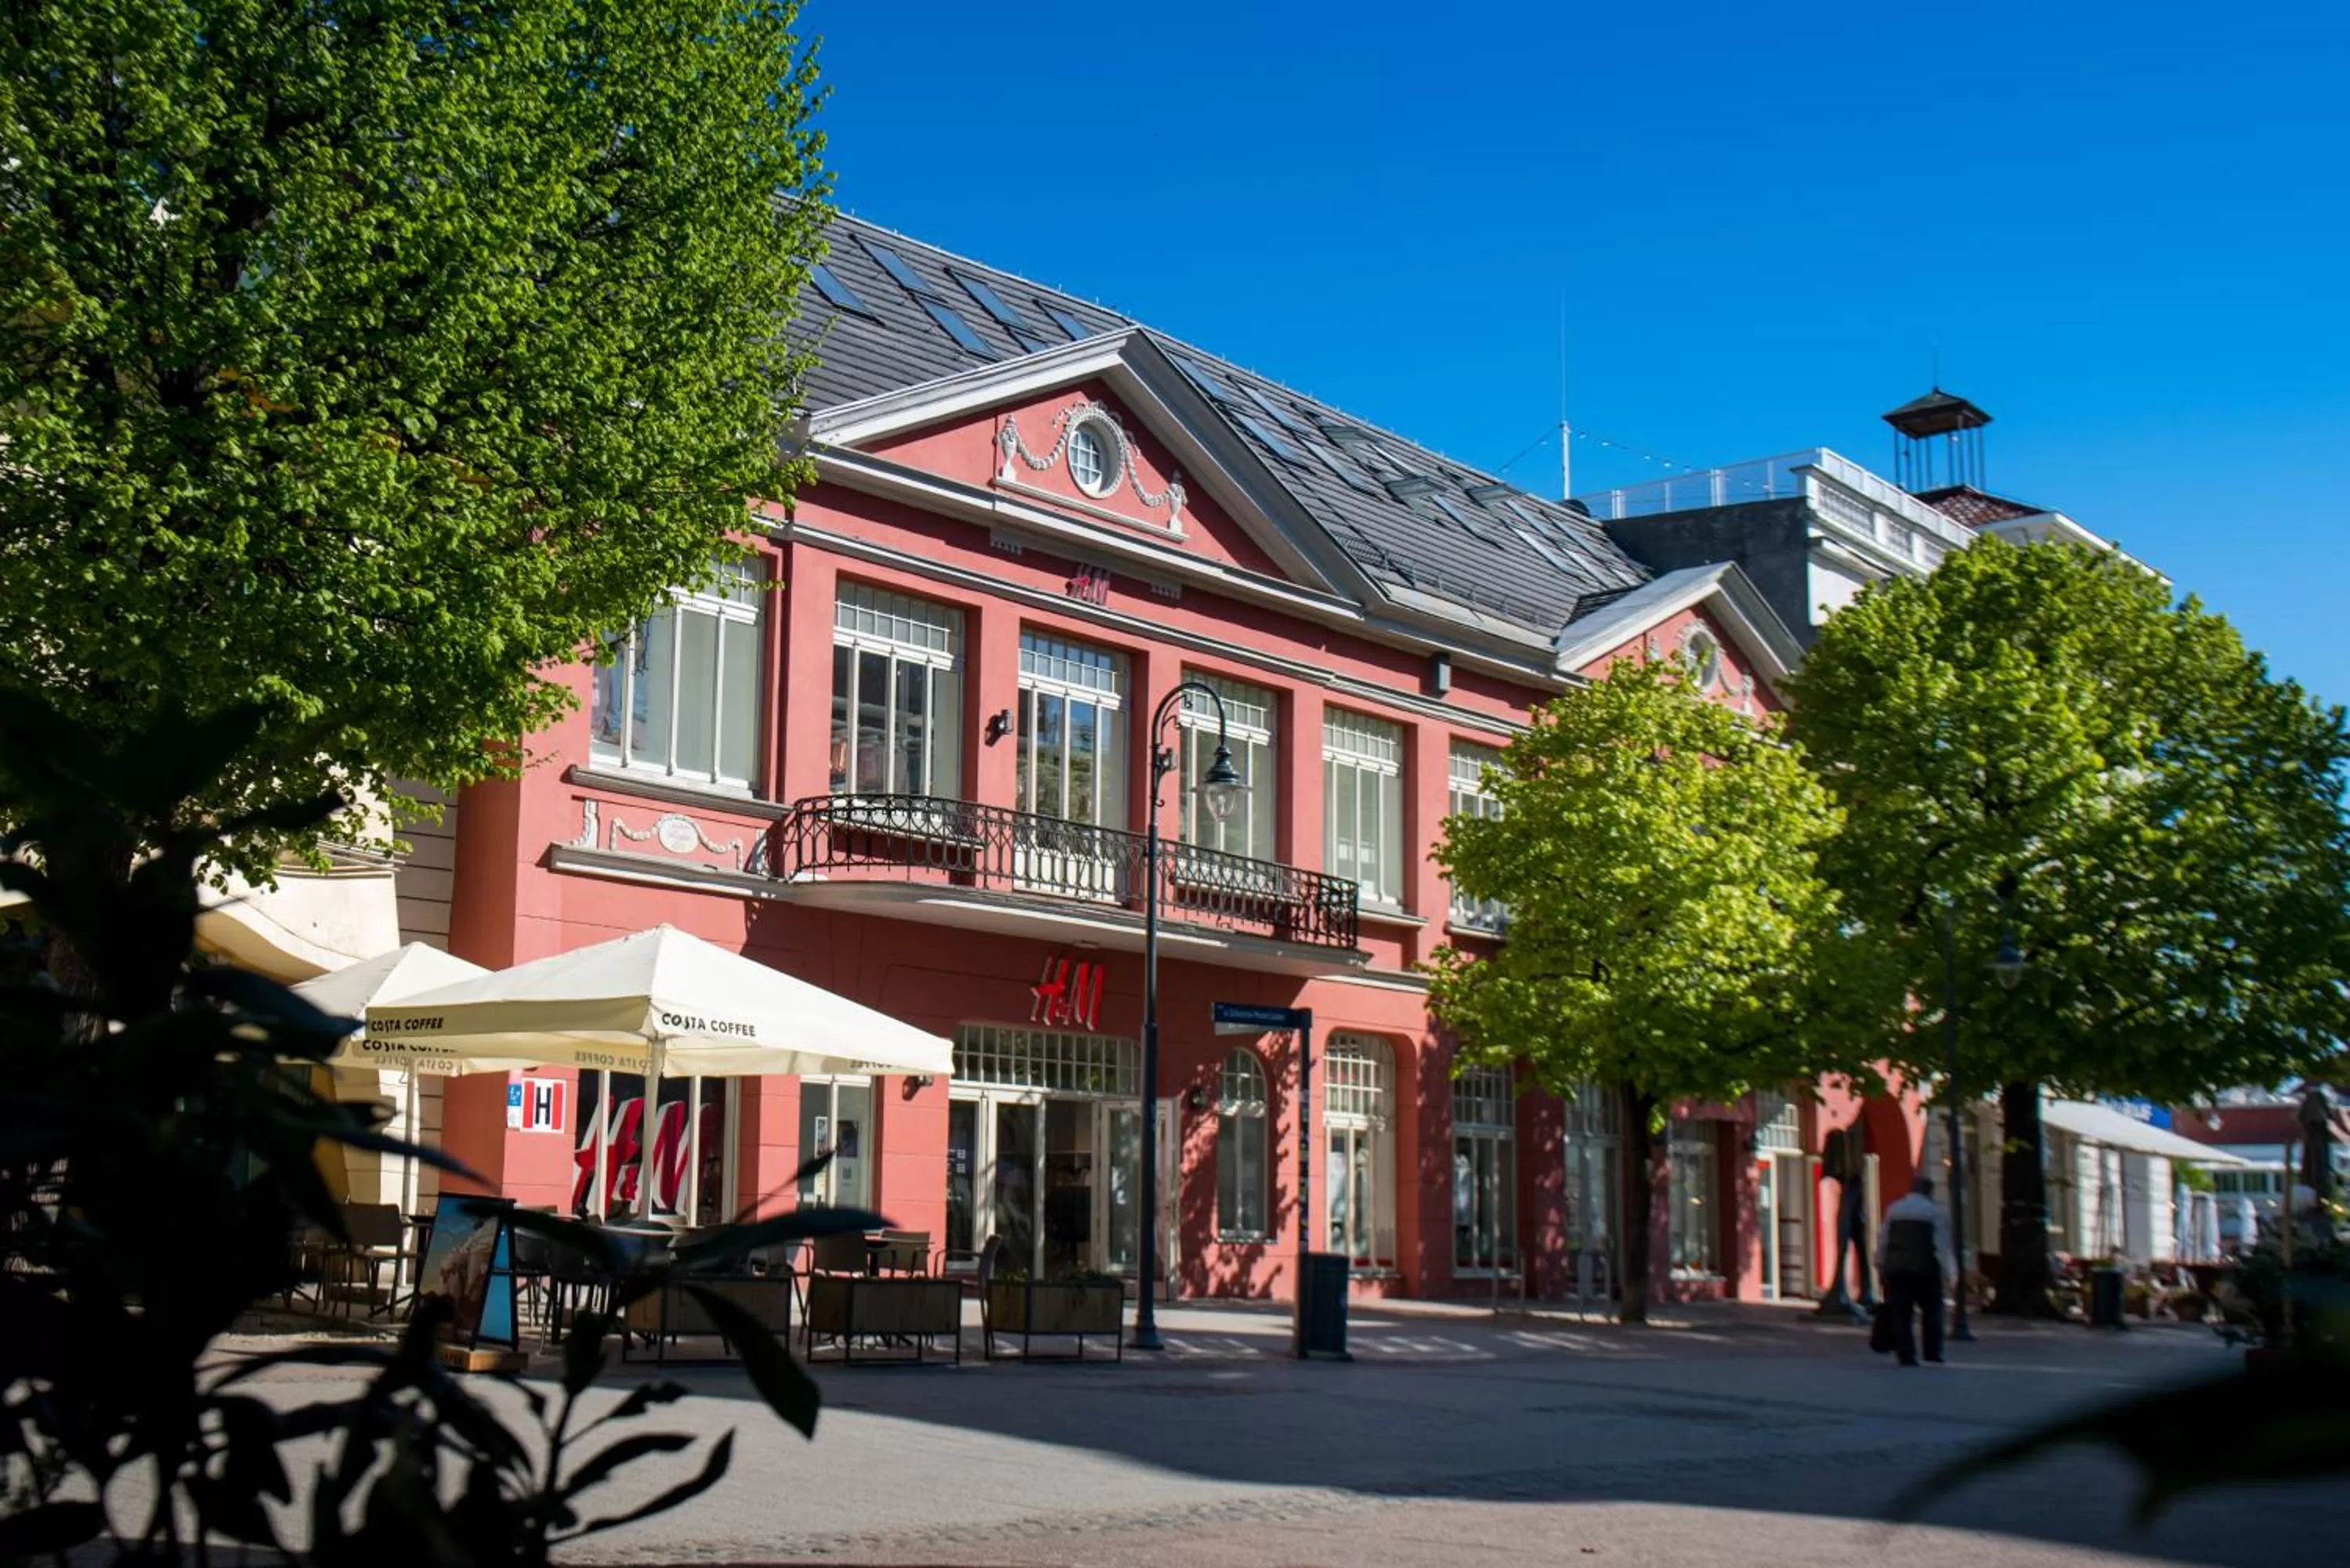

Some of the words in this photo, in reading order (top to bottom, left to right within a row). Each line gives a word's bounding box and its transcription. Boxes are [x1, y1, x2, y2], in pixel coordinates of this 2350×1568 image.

[1030, 952, 1104, 1031] H&M
[371, 1020, 401, 1034] COSTA
[404, 1017, 444, 1031] COFFEE
[662, 1013, 706, 1031] COSTA
[710, 1021, 757, 1038] COFFEE
[535, 1086, 551, 1125] H
